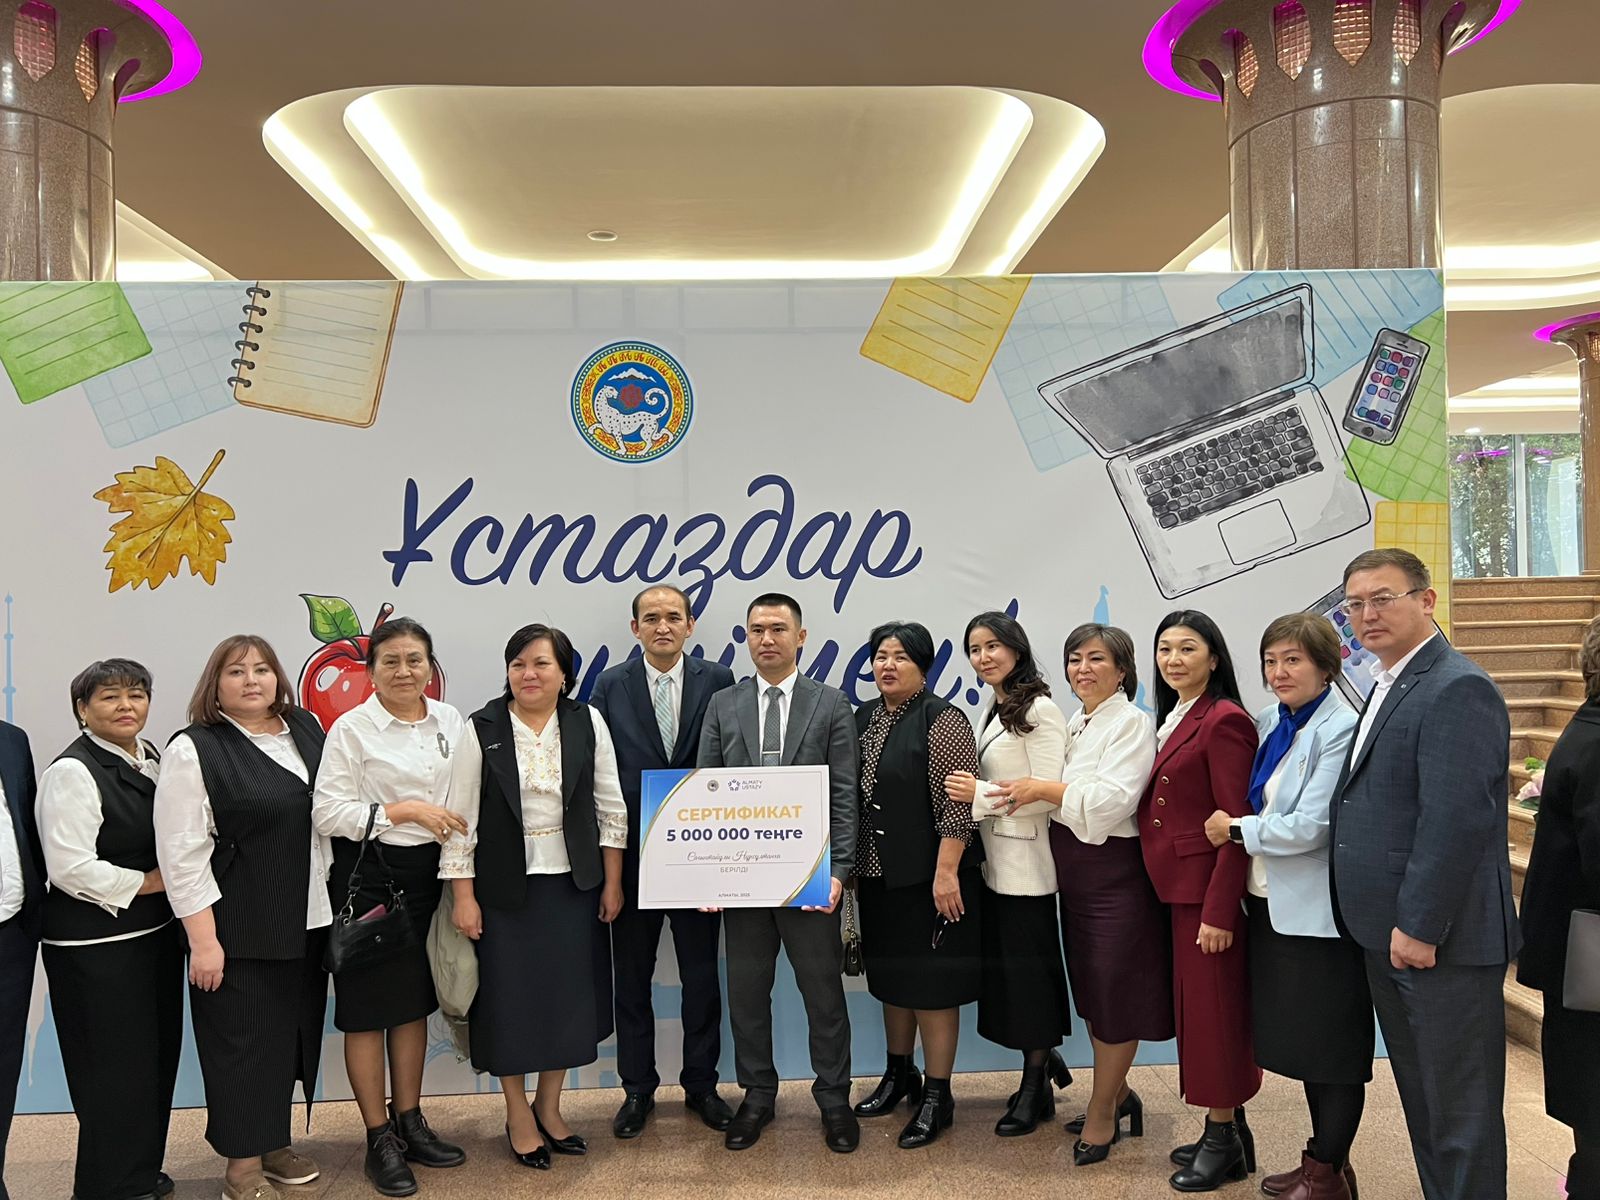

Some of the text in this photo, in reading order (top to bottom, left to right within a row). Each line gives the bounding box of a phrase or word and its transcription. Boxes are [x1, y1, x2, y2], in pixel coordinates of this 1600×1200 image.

[382, 474, 922, 622] Ұстаздар
[677, 805, 803, 822] СЕРТИФИКАТ
[666, 828, 803, 842] 5 000 000 теңге
